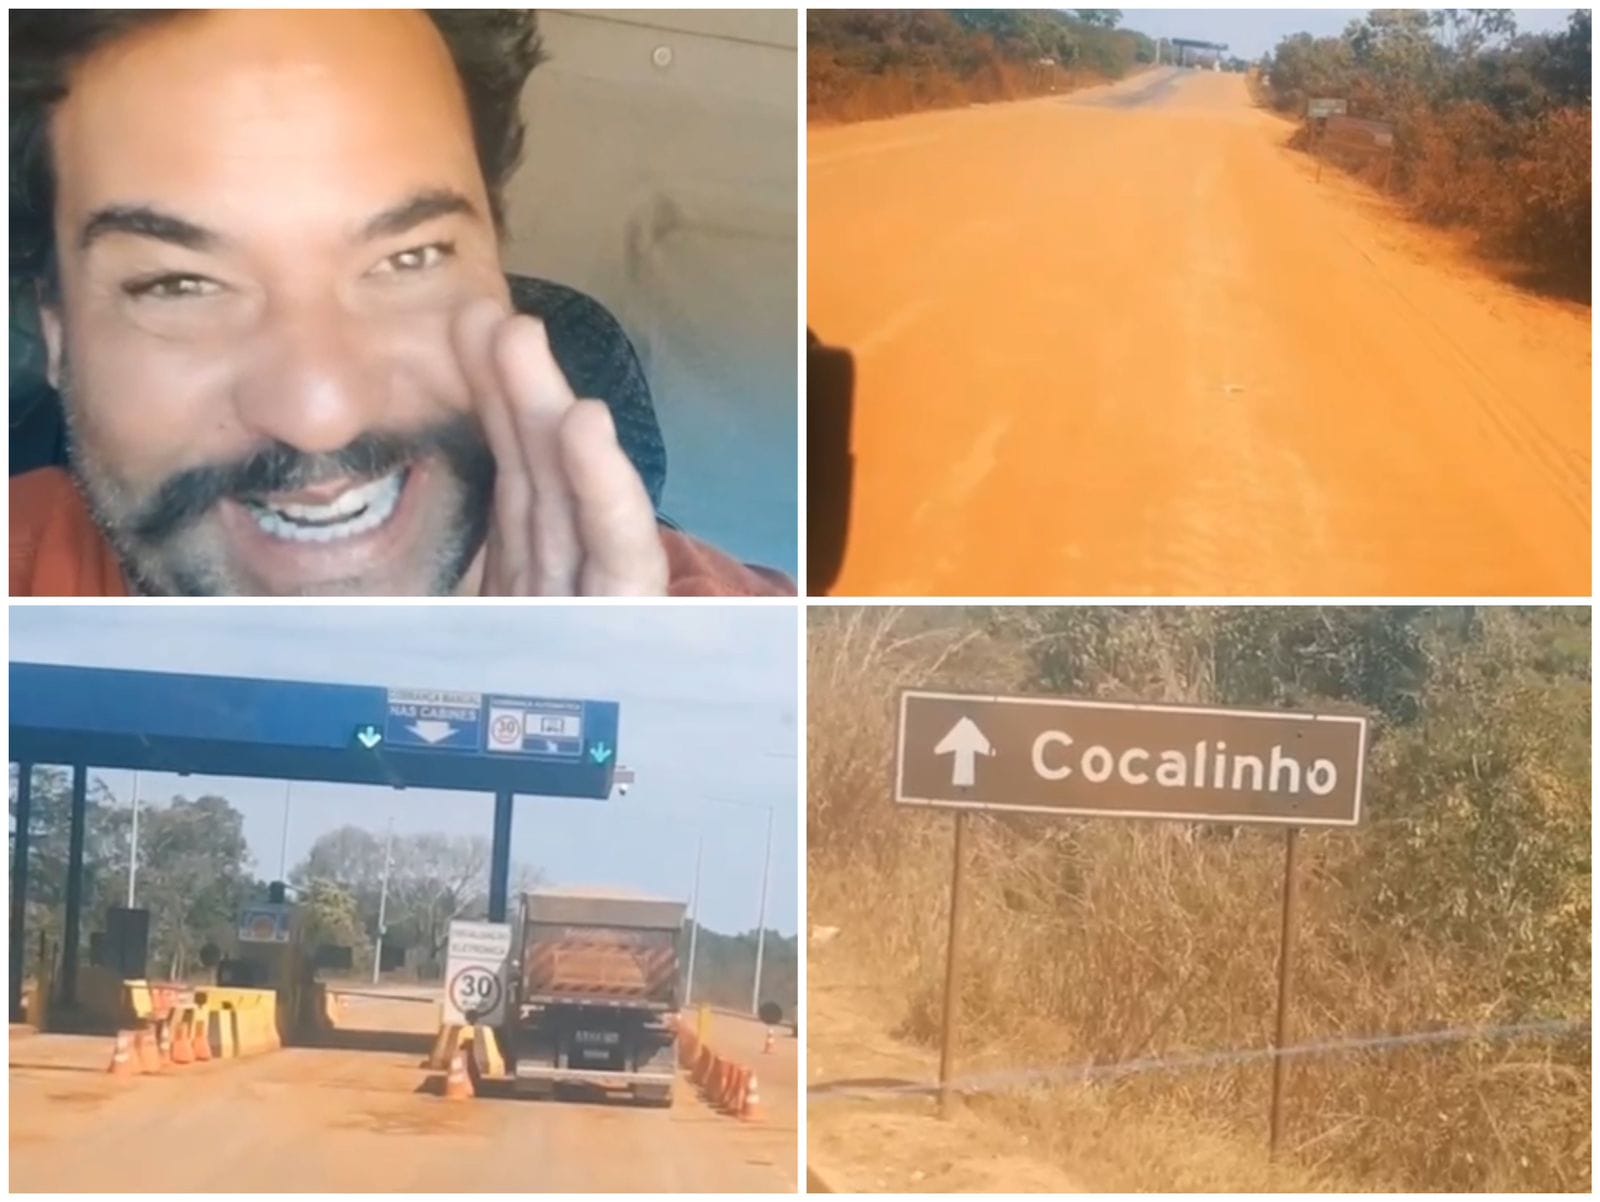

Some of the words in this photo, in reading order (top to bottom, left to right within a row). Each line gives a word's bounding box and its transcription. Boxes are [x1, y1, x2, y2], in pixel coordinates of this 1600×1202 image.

[389, 704, 416, 717] NAS
[498, 720, 516, 734] 30
[1031, 730, 1337, 796] Cocalinho
[460, 974, 492, 998] 30
